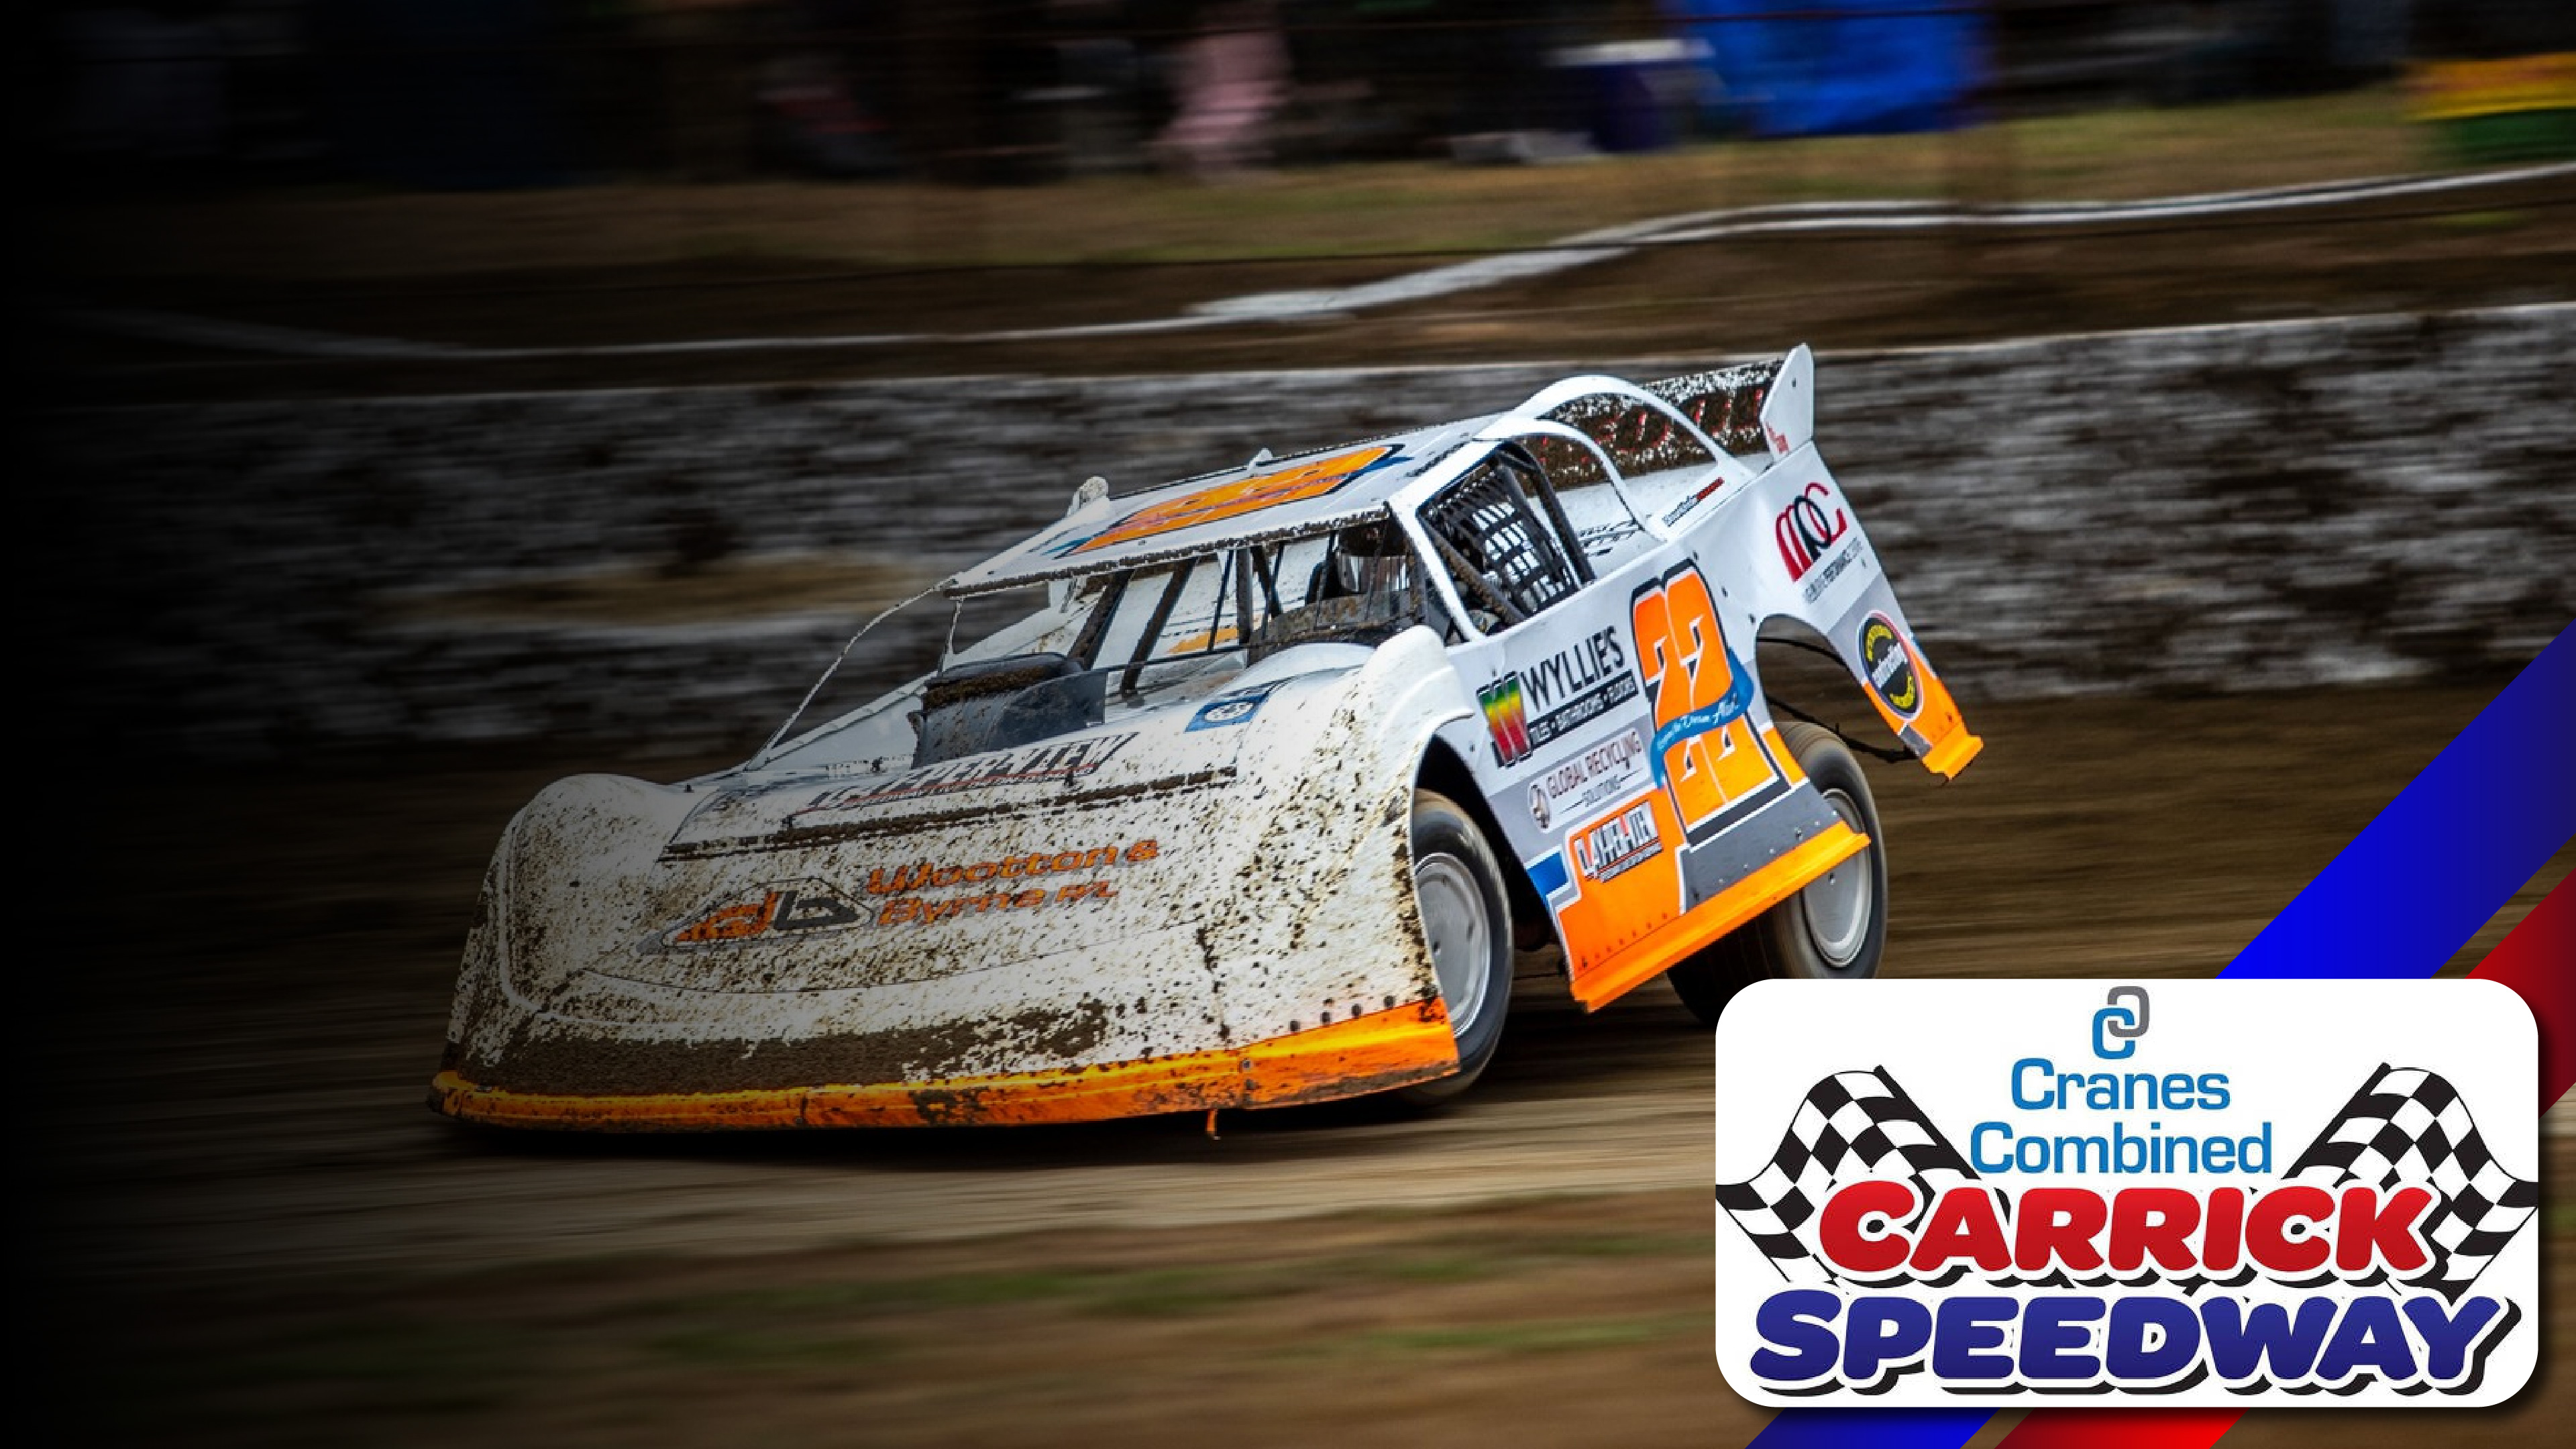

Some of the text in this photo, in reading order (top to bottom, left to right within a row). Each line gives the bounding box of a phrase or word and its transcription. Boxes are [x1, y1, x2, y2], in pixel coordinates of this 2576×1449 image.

[1546, 761, 1588, 798] GLOBAL
[866, 839, 1160, 895] Wootton &
[877, 888, 1044, 926] Byrne
